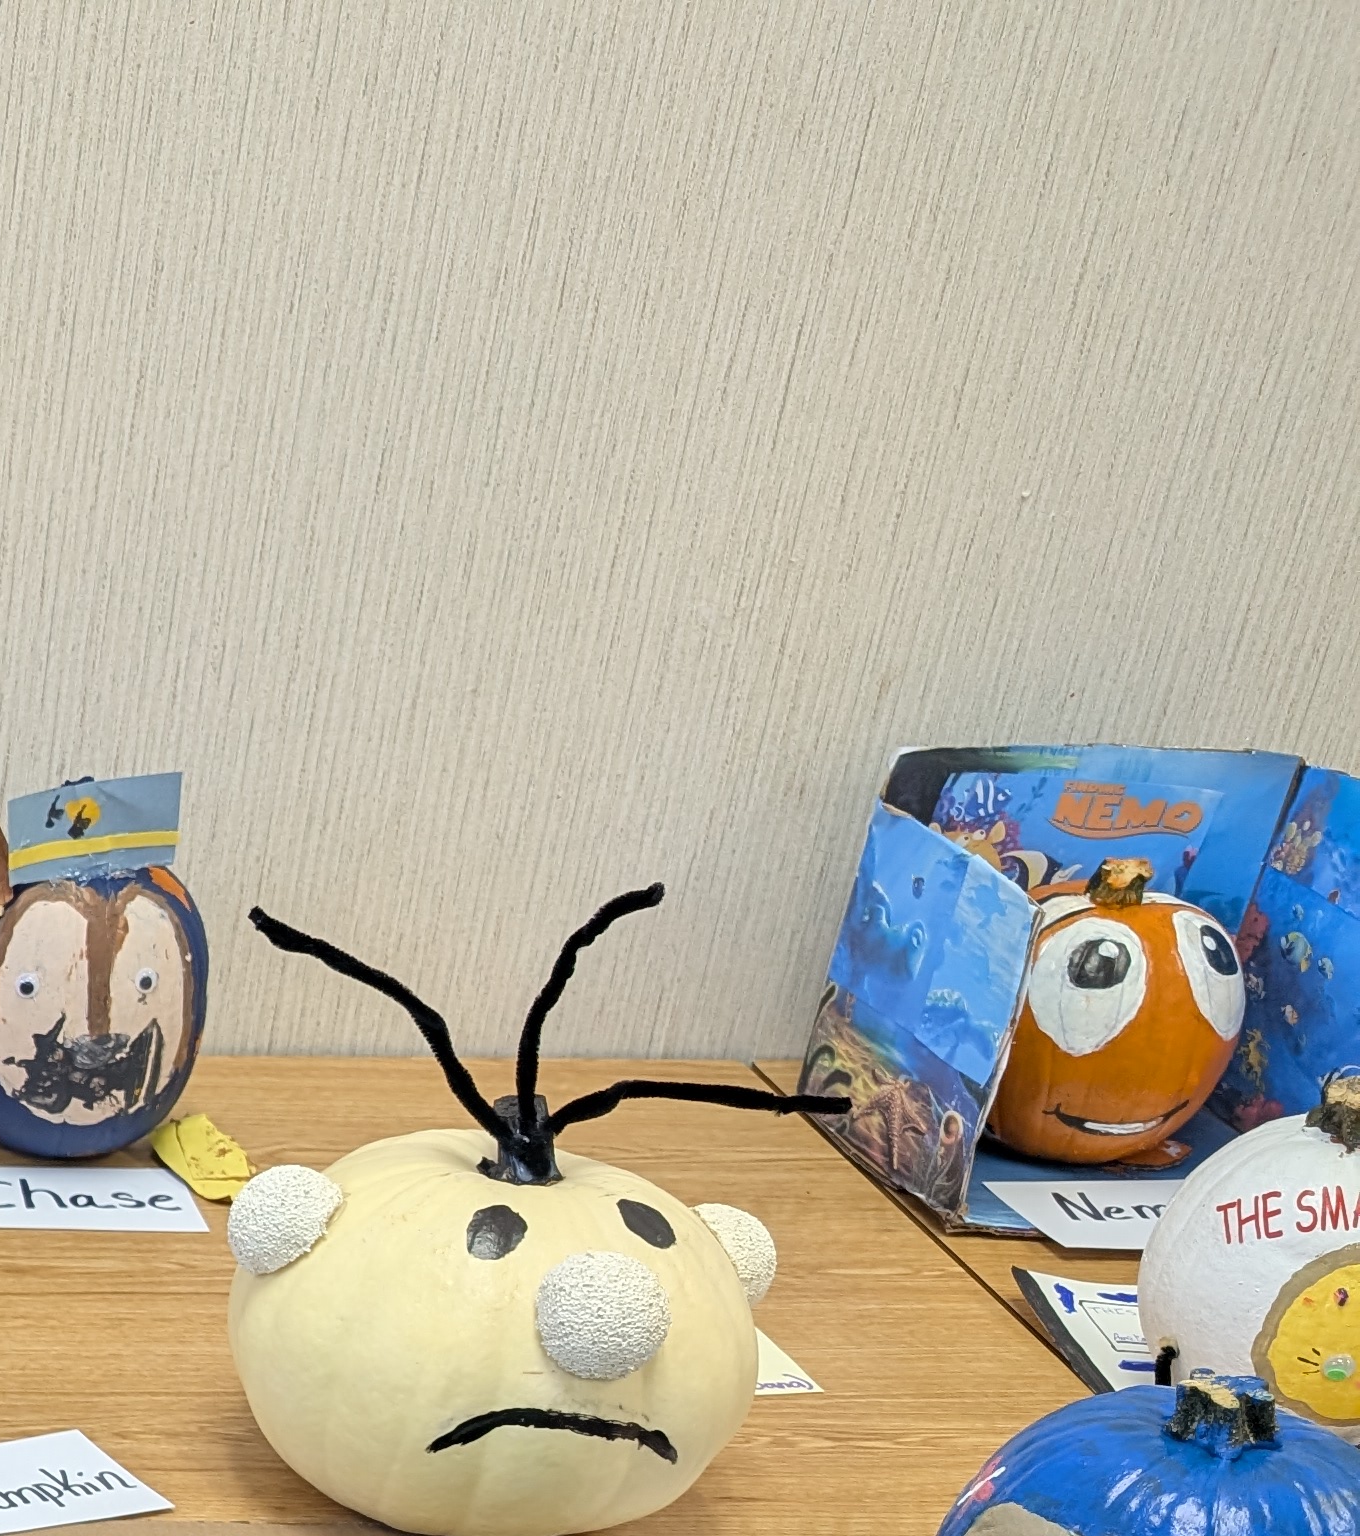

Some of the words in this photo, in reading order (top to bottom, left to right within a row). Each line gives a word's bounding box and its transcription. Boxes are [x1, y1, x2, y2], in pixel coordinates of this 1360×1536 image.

[1052, 792, 1204, 834] NEMO
[1051, 1191, 1168, 1222] Nem
[1216, 1191, 1283, 1244] THE
